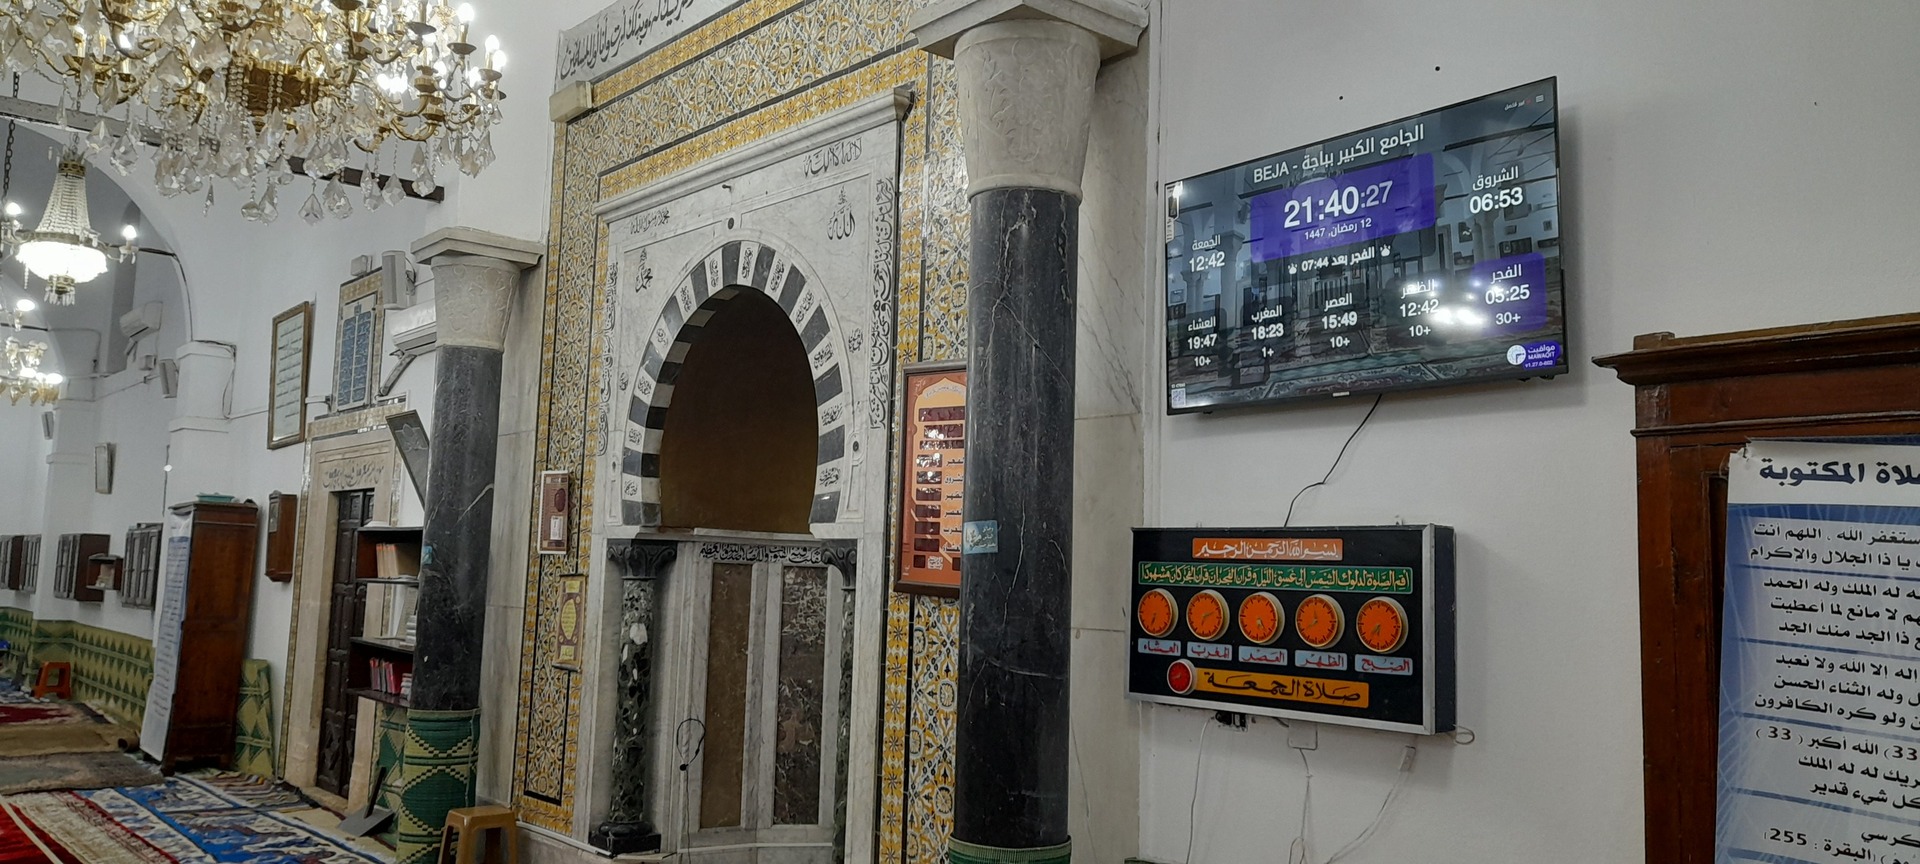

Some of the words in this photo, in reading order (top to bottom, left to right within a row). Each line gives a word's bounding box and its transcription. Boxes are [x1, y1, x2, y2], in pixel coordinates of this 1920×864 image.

[1379, 124, 1424, 155] الجامع
[1338, 137, 1375, 166] الكبير
[1302, 151, 1335, 172] بباجة
[1253, 161, 1289, 183] BEJA
[1472, 166, 1519, 191] الشروق
[1284, 180, 1393, 229] 21:40:27
[1469, 187, 1523, 214] 06:53
[1361, 217, 1372, 228] 12
[1304, 228, 1325, 240] 1447
[1192, 234, 1221, 251] الجمعة
[1189, 251, 1225, 273] 12:42
[1331, 254, 1348, 266] بعد
[1350, 246, 1375, 263] الفجر
[1301, 257, 1329, 272] 07:44
[1491, 264, 1522, 285] الفجر
[1401, 279, 1435, 299] الظهر
[1485, 284, 1530, 305] 05:25
[1324, 292, 1353, 312] العصر
[1400, 299, 1439, 318] 12:42
[1251, 304, 1283, 323] المغرب
[1322, 311, 1358, 330] 15:49
[1188, 316, 1217, 332] العشاء
[1251, 322, 1284, 341] 18:23
[1188, 333, 1217, 350] 19:47
[1759, 458, 1865, 487] المكتوبة
[1876, 461, 1920, 486] لاة
[1754, 522, 1780, 536] أنت
[1785, 528, 1822, 541] اللهم
[1836, 527, 1862, 541] الله
[1194, 540, 1247, 558] الرحيم
[1303, 540, 1339, 559] بسم
[1750, 546, 1817, 563] والإكرام
[1822, 549, 1872, 567] الجلال
[1878, 553, 1891, 567] ذا
[1897, 555, 1911, 571] يا
[1764, 577, 1808, 589] الحمد
[1813, 580, 1838, 595] وله
[1842, 583, 1877, 596] الملك
[1882, 586, 1900, 598] له
[1770, 597, 1824, 614] أعطيت
[1830, 602, 1842, 616] لما
[1847, 604, 1880, 621] مانع
[1885, 607, 1898, 620] لا
[1779, 621, 1812, 637] الجد
[1816, 623, 1850, 638] منك
[1855, 629, 1890, 645] الجد
[1896, 630, 1909, 644] ذا
[1143, 640, 1179, 654] العشاء
[1191, 644, 1230, 659] المغرب
[1242, 648, 1285, 663] العصر
[1301, 653, 1344, 668] الظهر
[1776, 653, 1810, 669] نعبد
[1362, 657, 1410, 673] الصبح
[1814, 655, 1835, 673] ولا
[1839, 657, 1865, 674] الله
[1870, 661, 1888, 679] إلا
[1774, 675, 1825, 691] الحسن
[1894, 667, 1918, 683] إله
[1203, 672, 1301, 699] الجمعة
[1303, 679, 1361, 704] صلاة
[1829, 681, 1871, 697] الثناء
[1754, 693, 1833, 714] الكافرون
[1876, 688, 1903, 704] وله
[1837, 707, 1877, 721] كره
[1882, 711, 1906, 728] ولو
[1808, 736, 1847, 750] أكبر
[1852, 739, 1879, 755] الله
[1798, 755, 1832, 770] الملك
[1838, 763, 1855, 775] له
[1860, 767, 1878, 779] له
[1810, 781, 1849, 797] قدير
[1852, 789, 1888, 806] شيء
